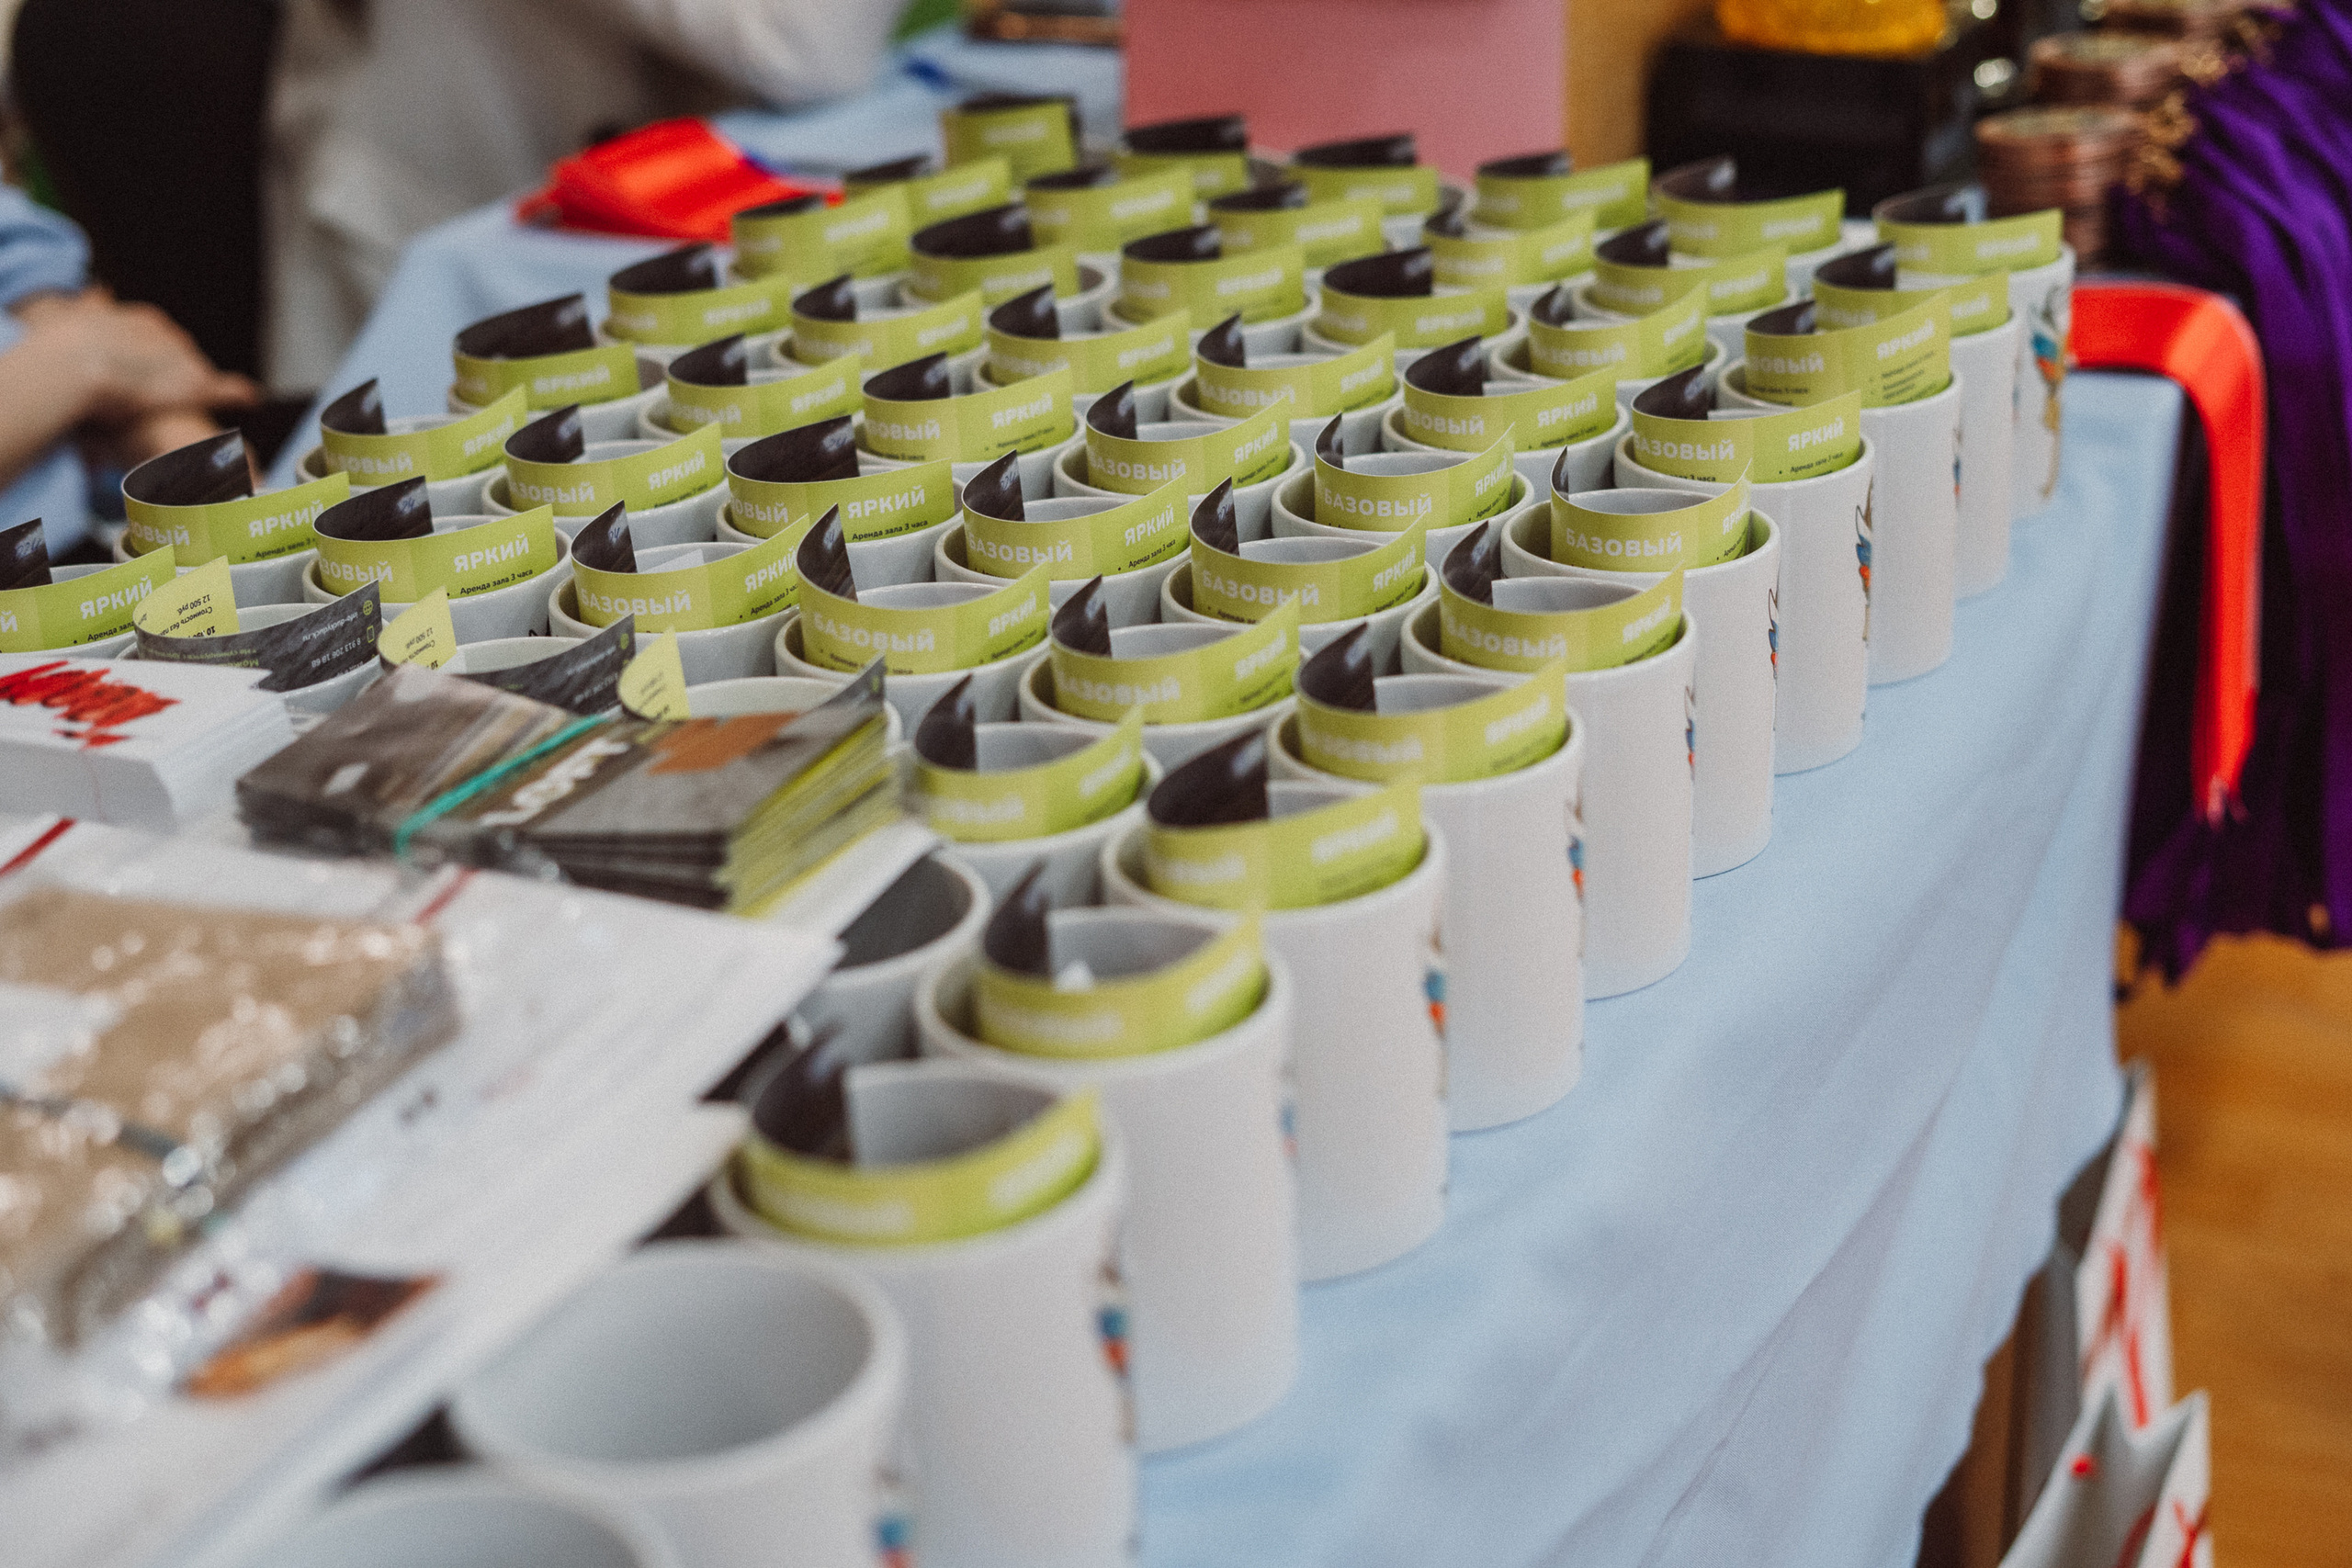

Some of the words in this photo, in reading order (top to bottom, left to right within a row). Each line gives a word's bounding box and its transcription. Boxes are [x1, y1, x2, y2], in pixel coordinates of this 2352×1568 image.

[1788, 417, 1844, 452] ЯРКИЙ
[847, 485, 926, 520] ЯРКИЙ
[1324, 488, 1432, 518] БАЗОВЫЙ
[248, 499, 324, 539] ЯРКИЙ
[852, 529, 884, 541] Аренда
[885, 525, 903, 536] зала
[905, 522, 910, 531] 3
[911, 520, 929, 529] часа
[1125, 503, 1175, 547] ЯРКИЙ
[453, 533, 530, 574] ЯРКИЙ
[967, 532, 1073, 563] БАЗОВЫЙ
[1566, 527, 1682, 558] БАЗОВЫЙ
[460, 582, 492, 596] Аренда
[492, 578, 510, 589] зала
[511, 572, 516, 582] 3
[517, 569, 534, 579] часа
[745, 546, 797, 593] ЯРКИЙ
[80, 575, 153, 621] ЯРКИЙ
[189, 598, 202, 609] 500
[202, 593, 210, 604] 12
[581, 589, 691, 616] БАЗОВЫЙ
[751, 600, 775, 616] Аренда
[180, 605, 213, 626] Стоимость
[87, 627, 118, 642] Аренда
